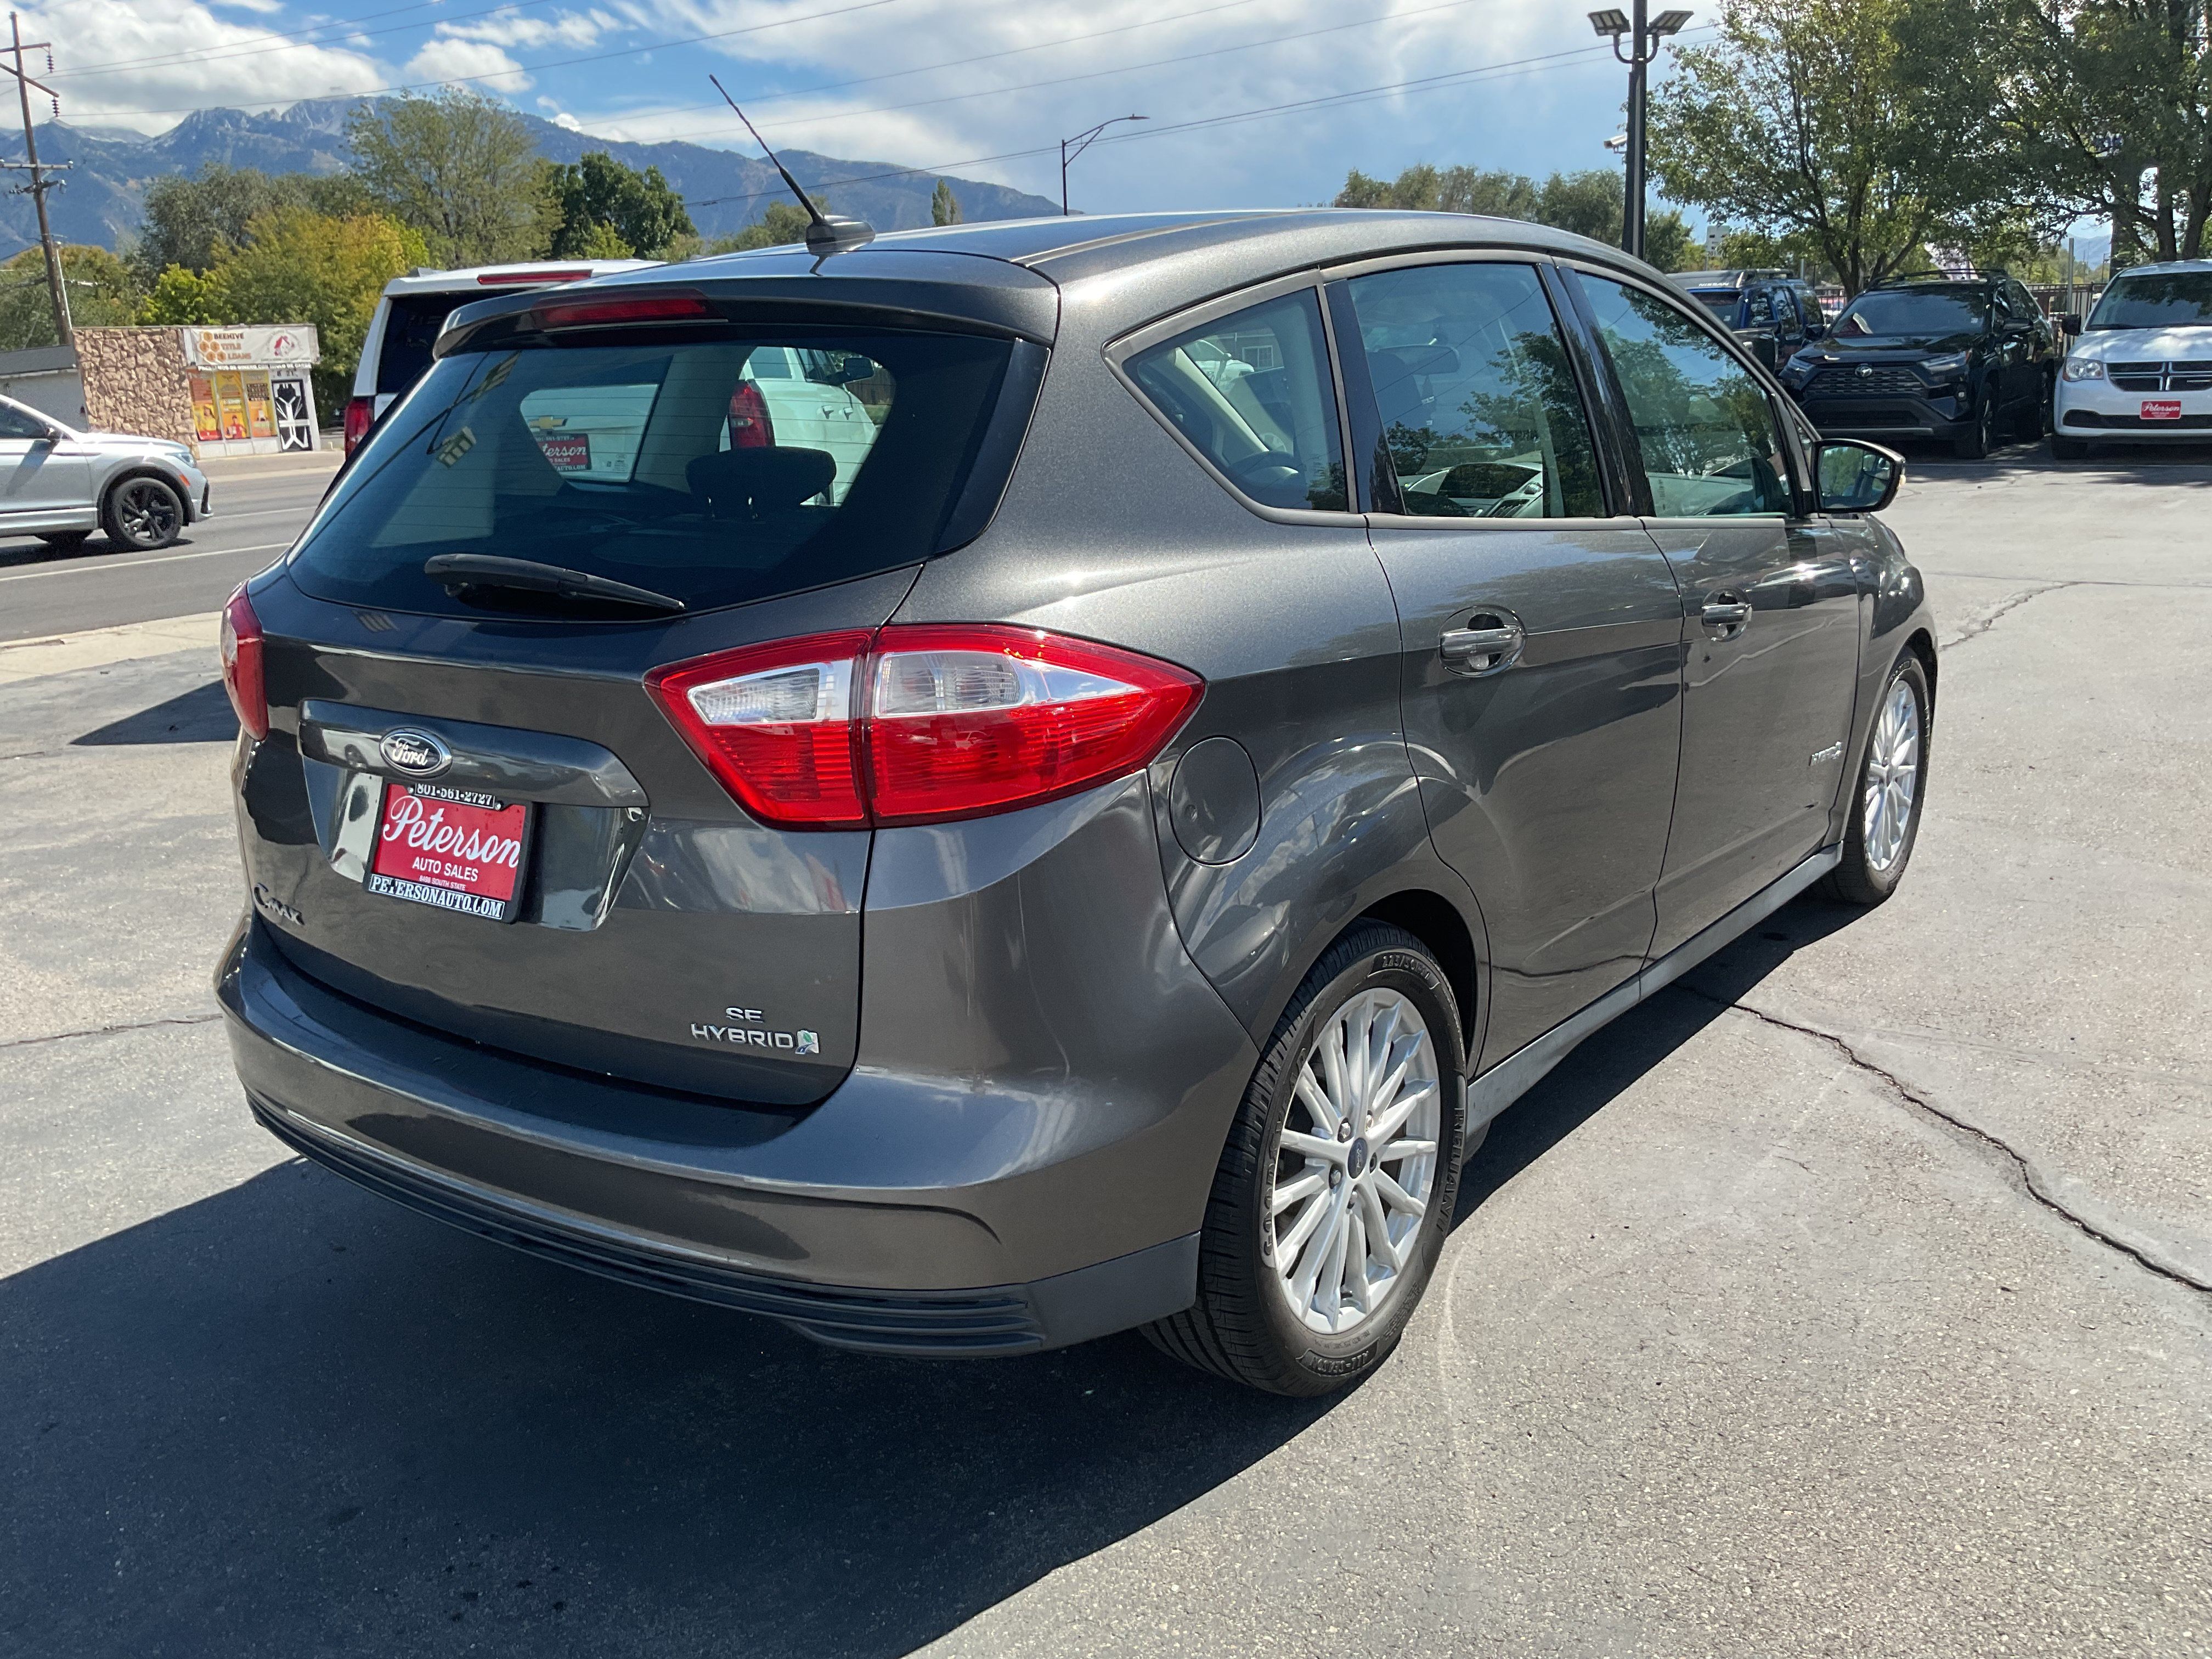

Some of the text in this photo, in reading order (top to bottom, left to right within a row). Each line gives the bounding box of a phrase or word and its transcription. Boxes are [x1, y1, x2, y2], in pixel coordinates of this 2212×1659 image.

[2142, 403, 2180, 411] Peterson
[542, 443, 587, 457] terson
[392, 737, 429, 766] Ford
[416, 783, 493, 806] 801-561-2727
[382, 795, 521, 868] Peterson
[412, 856, 479, 882] AUTO SALES
[432, 877, 450, 887] SOUTH
[450, 882, 466, 891] STATE
[725, 1006, 764, 1023] SE
[690, 1023, 794, 1049] HYBRID
